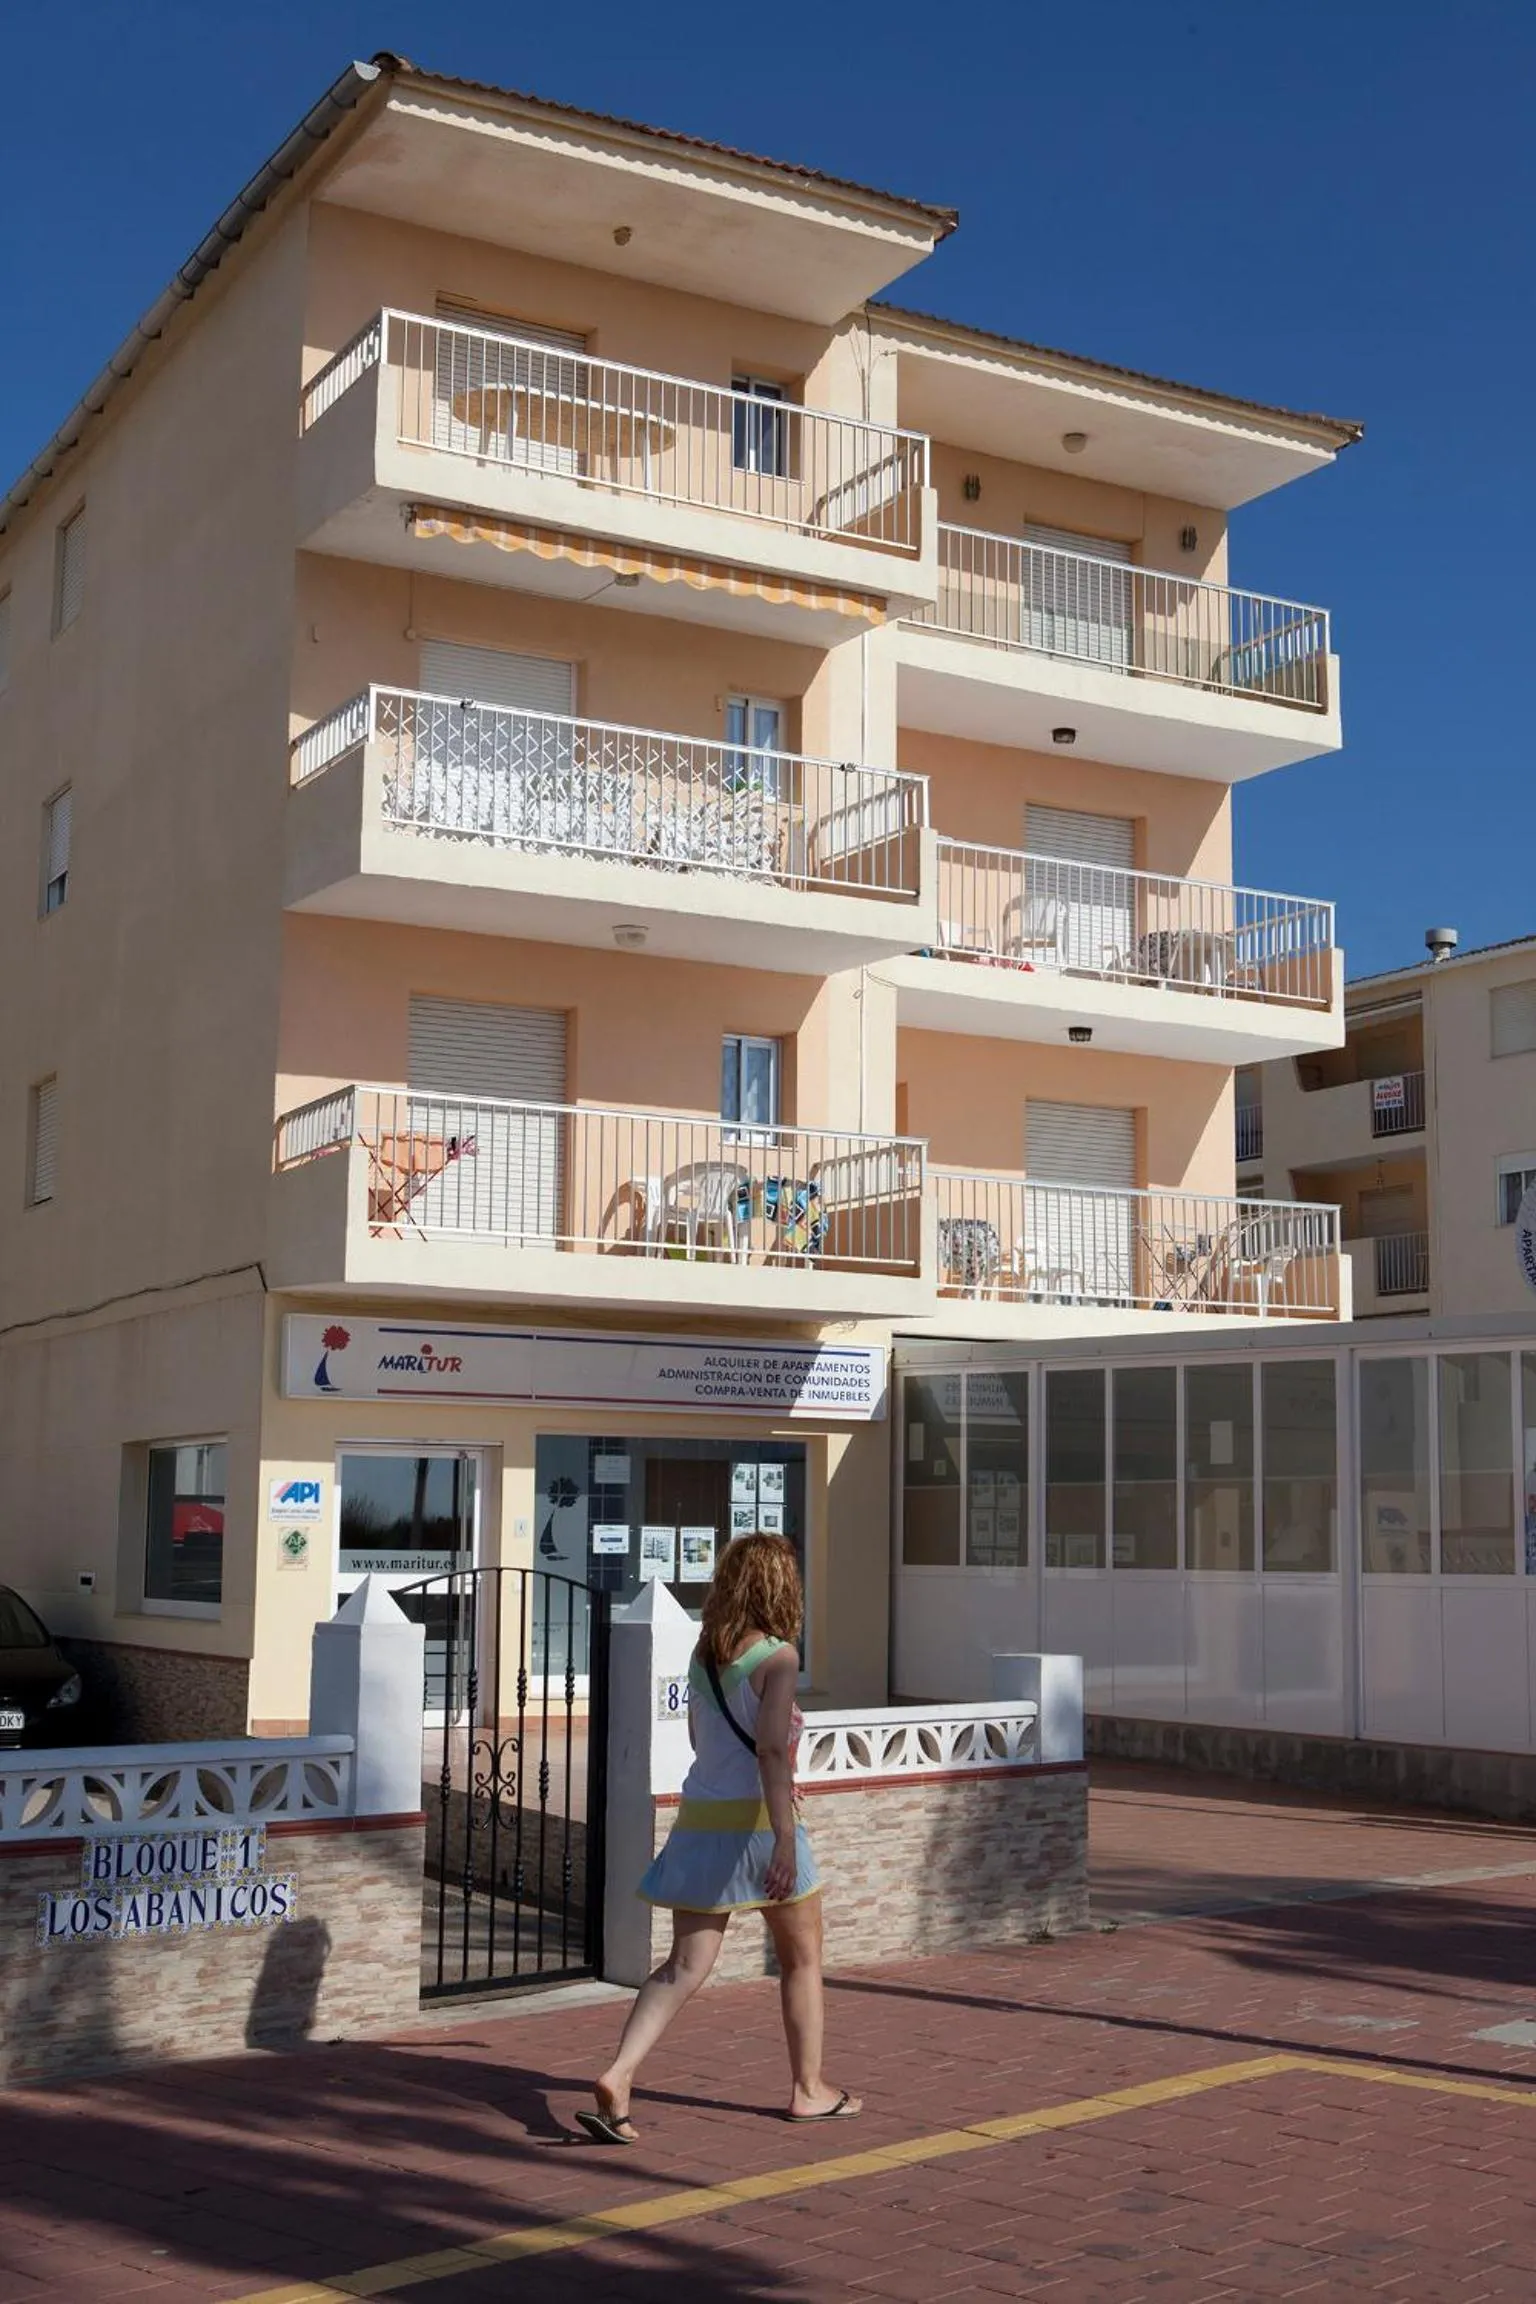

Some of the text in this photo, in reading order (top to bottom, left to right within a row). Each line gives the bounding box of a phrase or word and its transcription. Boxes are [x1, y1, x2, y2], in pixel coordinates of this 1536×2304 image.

[704, 1357, 870, 1374] ALQUILER DE APARTAMENTOS
[658, 1368, 870, 1387] ADMINISTRACION DE COMUNIDADES
[695, 1384, 870, 1402] COMPRA-VENTA DE INMUEBLES
[281, 1481, 319, 1504] API
[93, 1835, 251, 1880] BLOQUE 1
[49, 1884, 288, 1936] LOS ABANICOS
